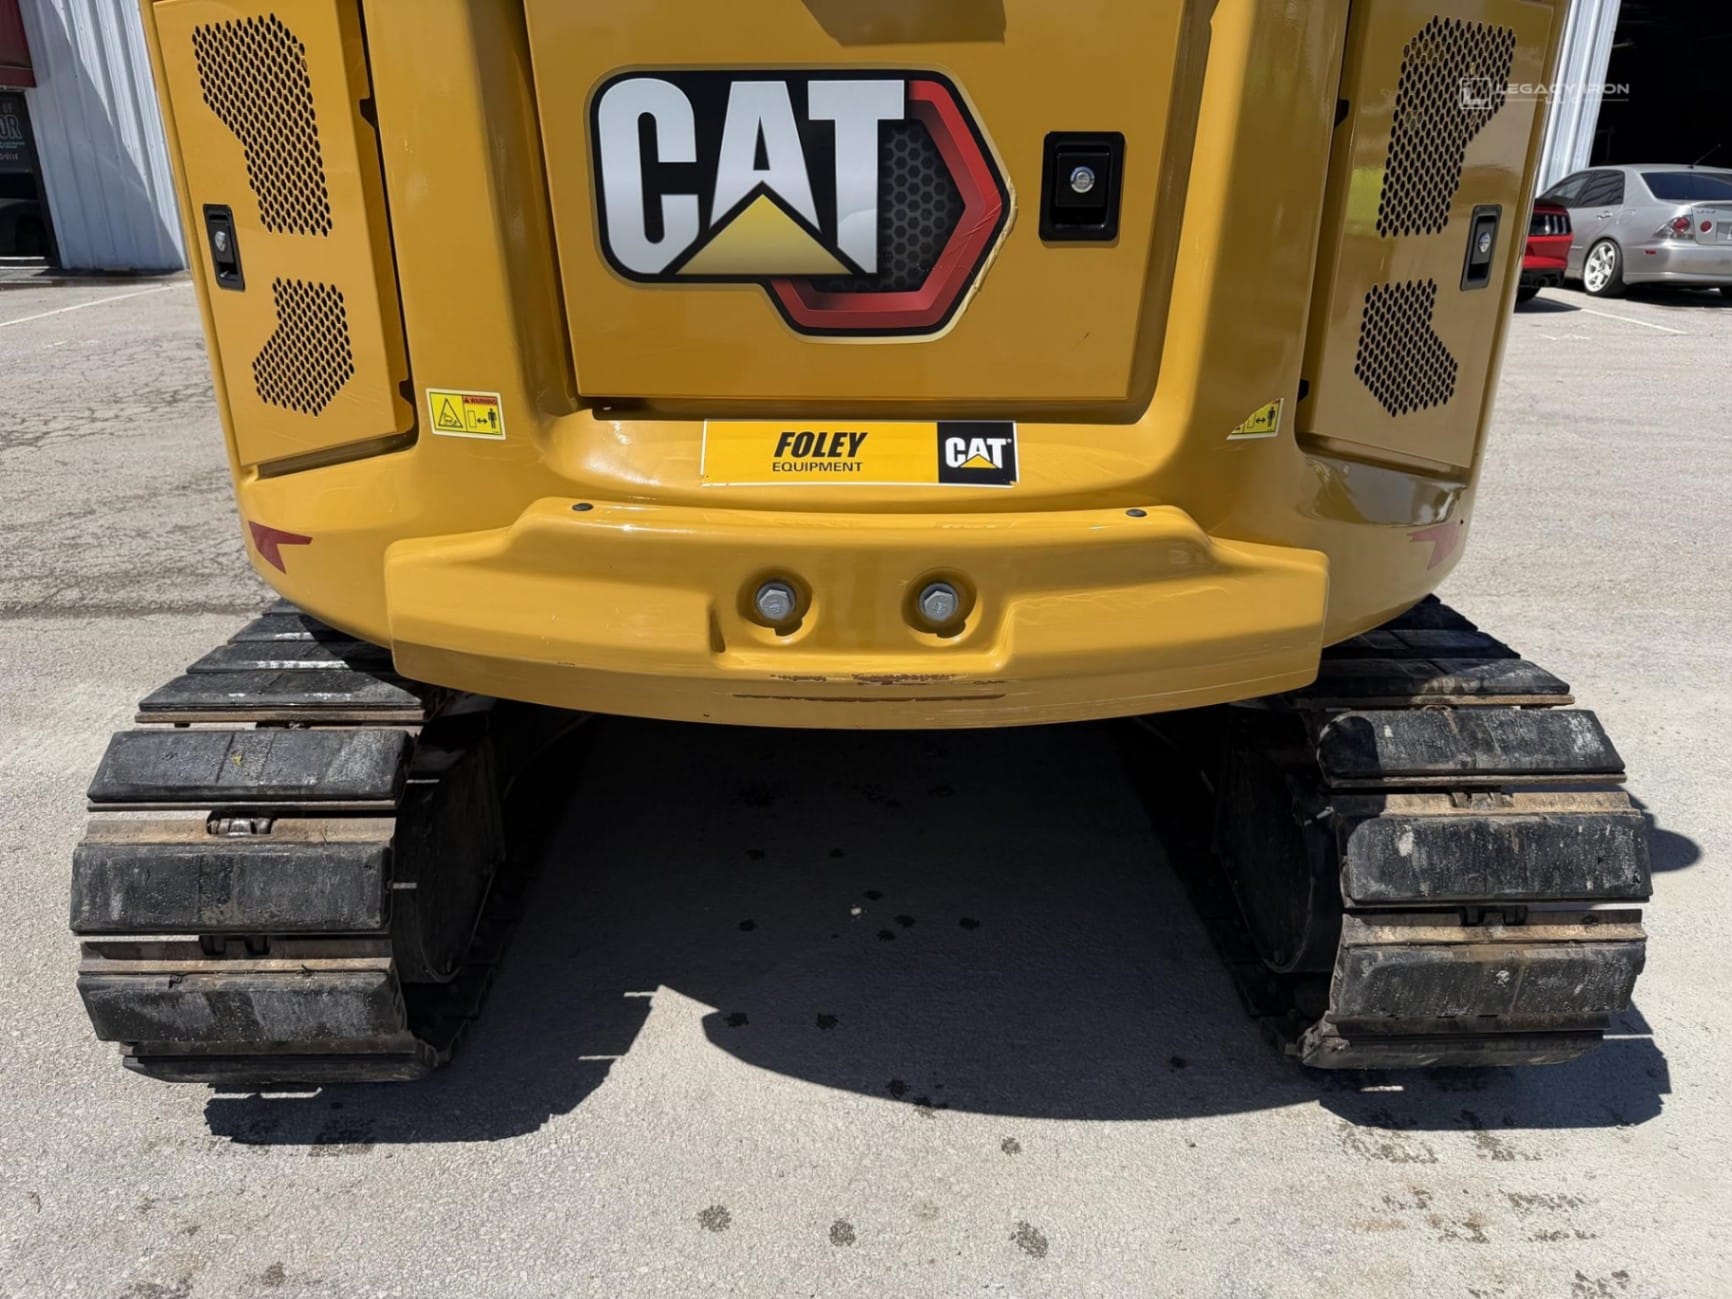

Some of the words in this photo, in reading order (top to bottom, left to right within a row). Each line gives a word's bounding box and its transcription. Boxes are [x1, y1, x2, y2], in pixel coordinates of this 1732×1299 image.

[597, 78, 905, 275] CAT
[773, 431, 868, 458] FOLEY
[945, 437, 1006, 469] CAT
[772, 462, 863, 472] EQUIPMENT
